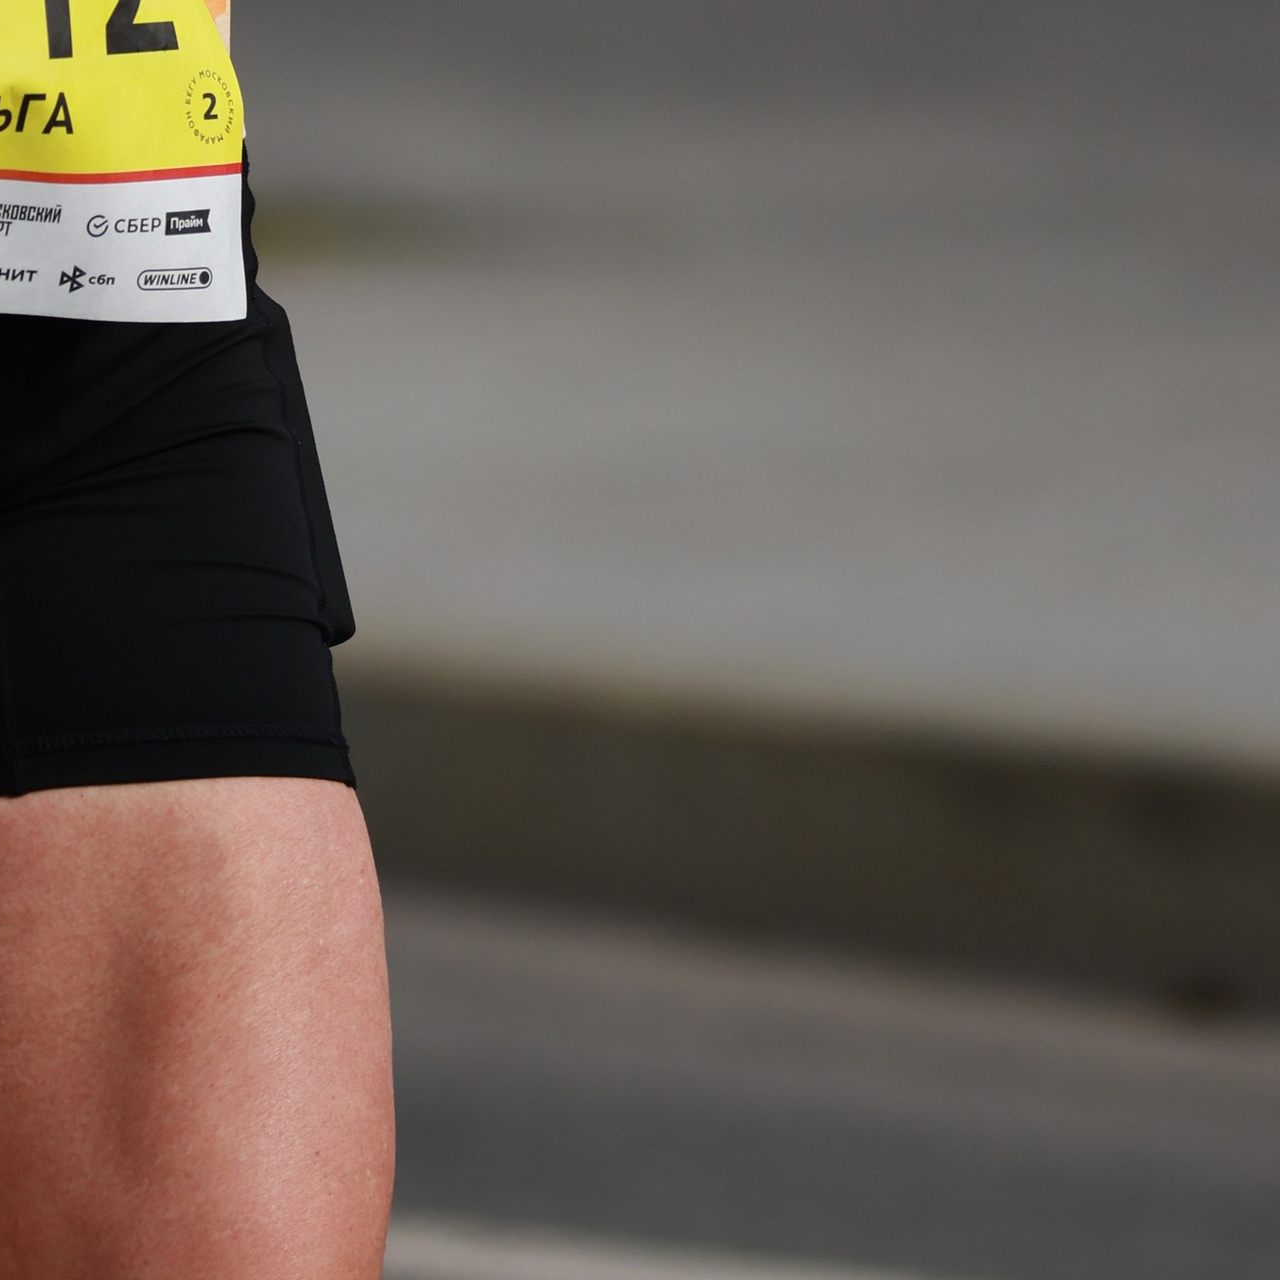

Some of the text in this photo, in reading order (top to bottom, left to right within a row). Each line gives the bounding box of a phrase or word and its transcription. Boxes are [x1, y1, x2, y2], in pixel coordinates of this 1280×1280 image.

[202, 92, 219, 120] 2
[114, 217, 203, 233] СБЕР Прайм
[143, 273, 197, 286] WINLINE
